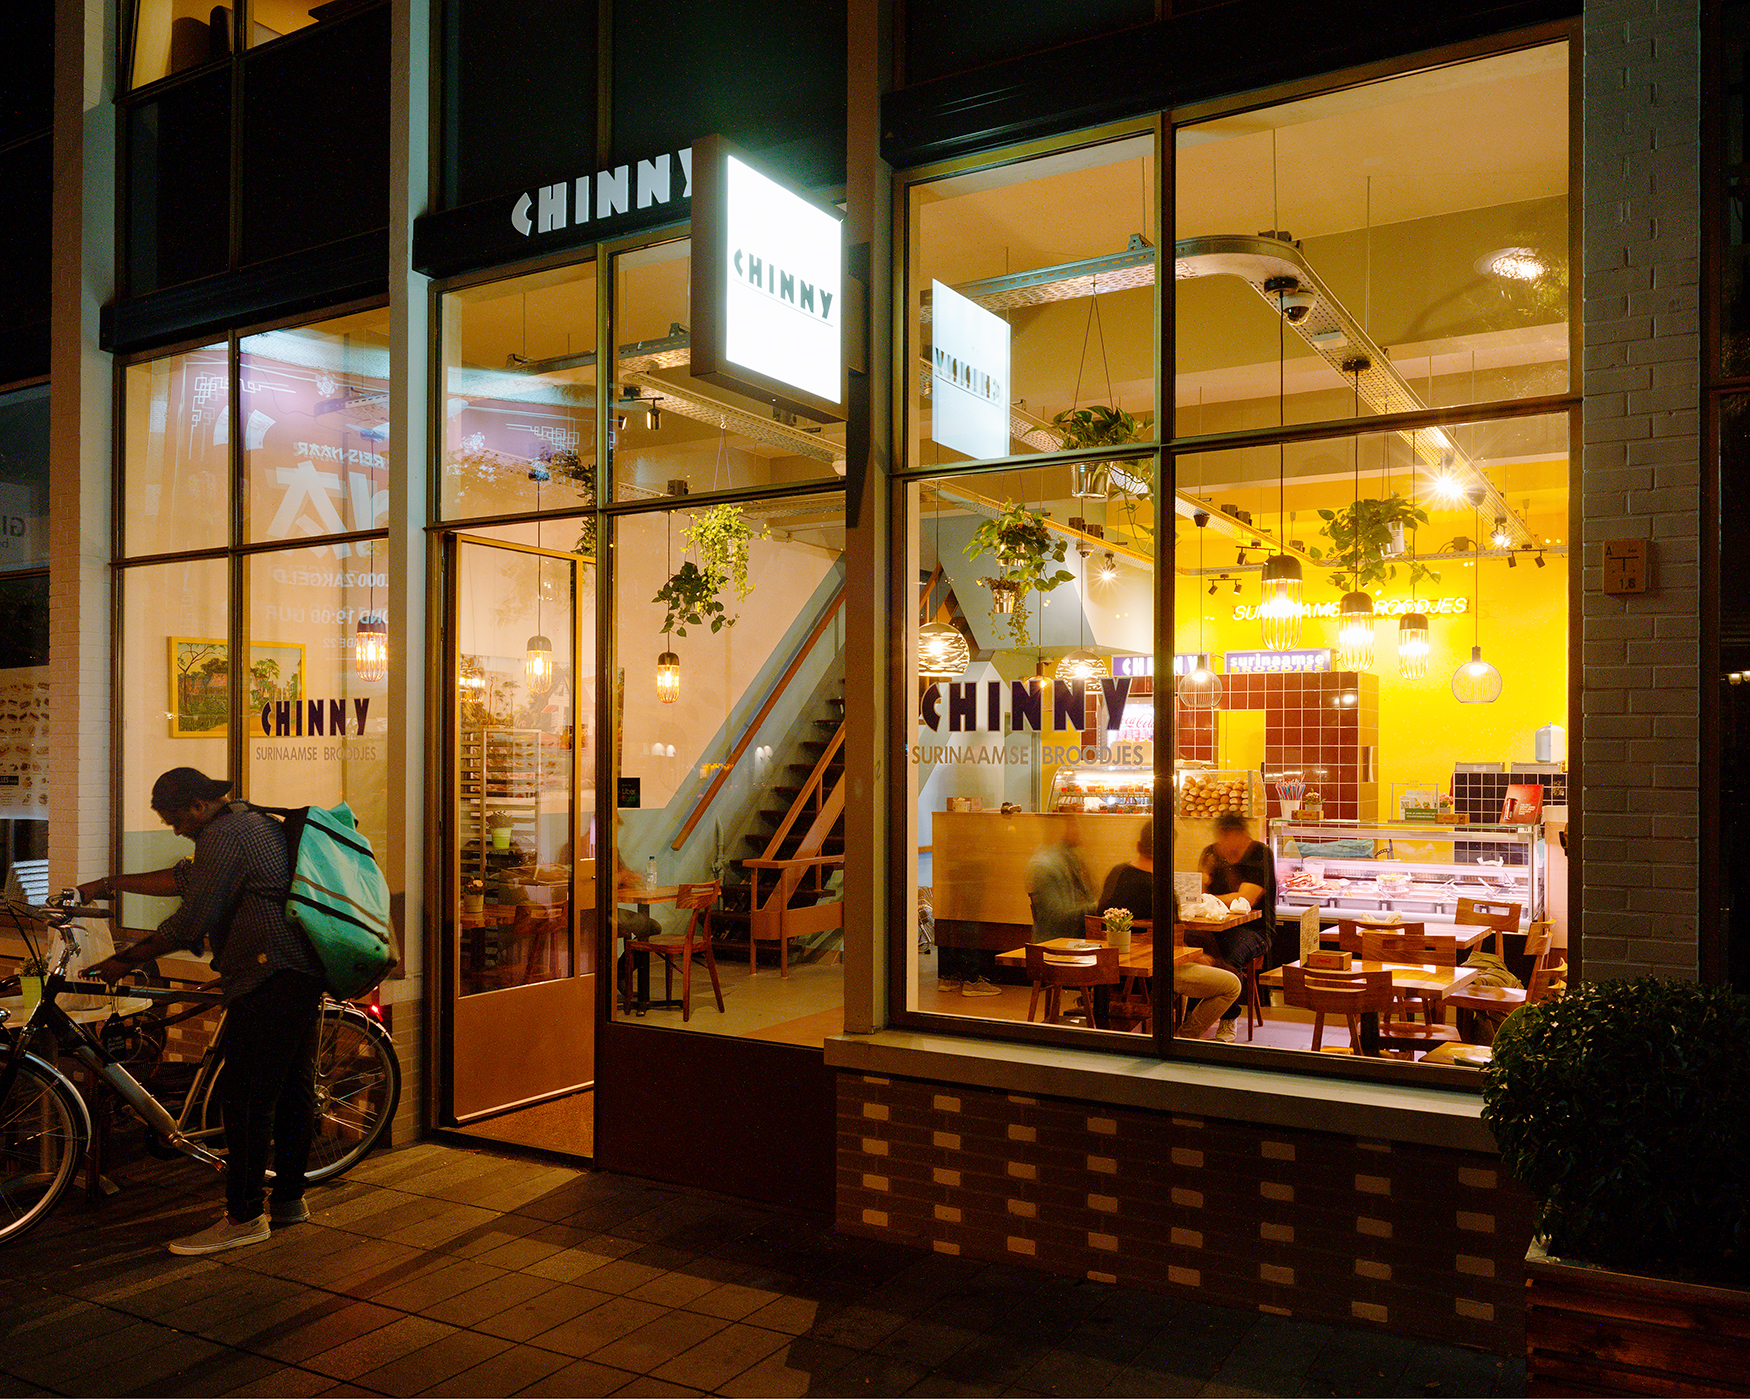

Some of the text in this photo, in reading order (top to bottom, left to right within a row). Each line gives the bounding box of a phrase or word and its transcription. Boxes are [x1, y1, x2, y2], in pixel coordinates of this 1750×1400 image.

[734, 248, 833, 320] CHINNY
[1372, 597, 1468, 616] ROODJES
[1122, 655, 1201, 676] CHINY
[1229, 653, 1325, 667] surinaamse
[1229, 664, 1325, 674] BROODJES
[921, 677, 1133, 733] CHINNY
[261, 697, 370, 737] CHINNY
[255, 746, 377, 761] SURINAAMSE BROODJES
[911, 745, 1144, 766] SURINAAMSE BROODJES
